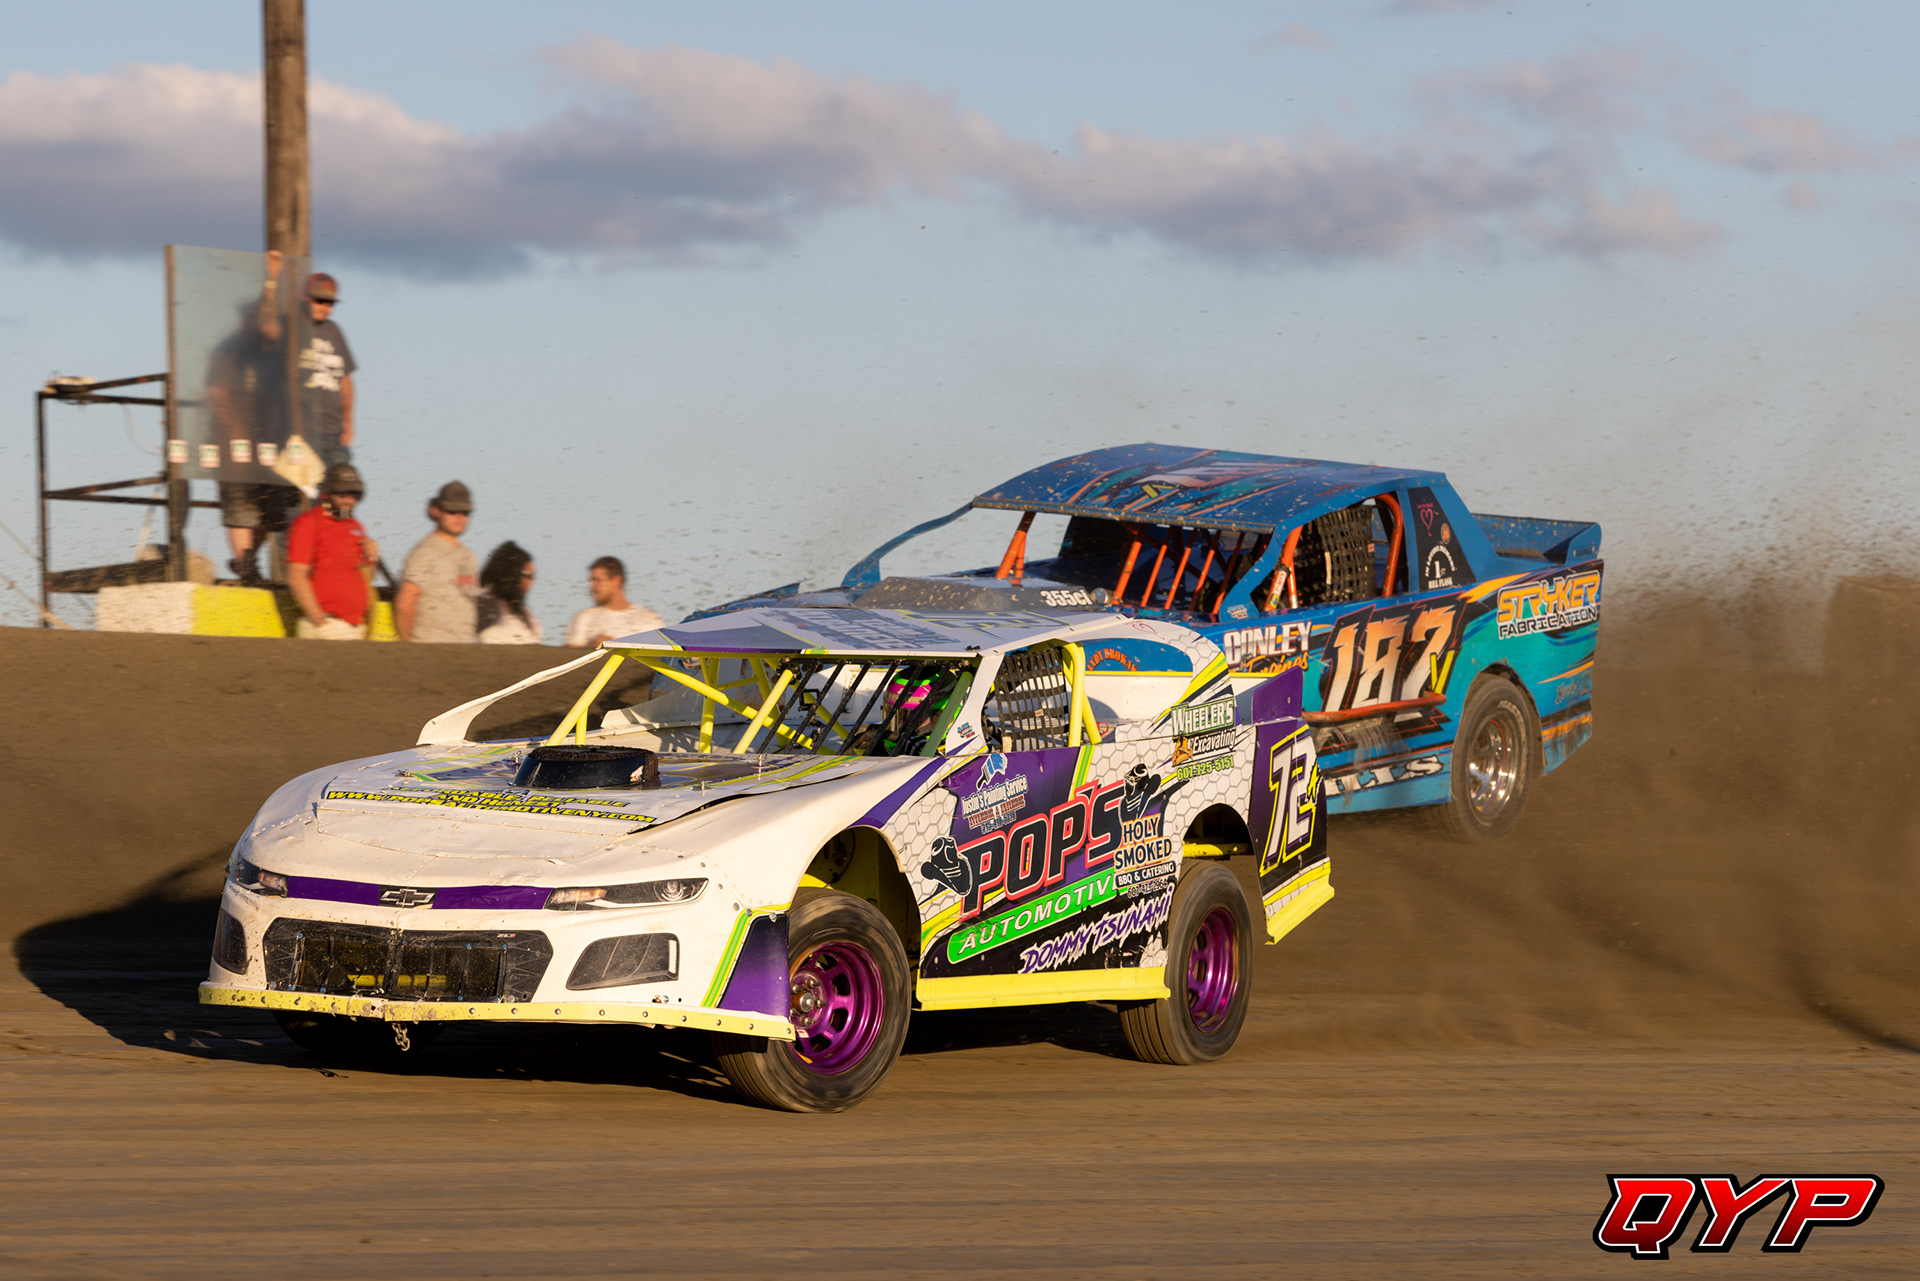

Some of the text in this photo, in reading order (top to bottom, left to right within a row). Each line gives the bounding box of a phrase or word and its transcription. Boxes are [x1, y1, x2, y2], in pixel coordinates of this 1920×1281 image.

[1040, 589, 1093, 607] 355ci
[1498, 574, 1600, 622] STRYKER
[1499, 606, 1597, 638] FABRICATION
[1224, 620, 1311, 666] CONLEY
[1171, 700, 1234, 738] WHEELER'S
[1193, 730, 1235, 753] Excavating
[1177, 754, 1235, 780] 607-725-5151
[433, 793, 481, 805] AND
[1006, 774, 1027, 799] Service
[1122, 815, 1160, 844] HOLY
[957, 780, 1126, 921] POP'S
[1114, 838, 1173, 871] SMOKED
[1117, 862, 1175, 887] BBQ & CATERING
[1018, 921, 1094, 974] DOMMY
